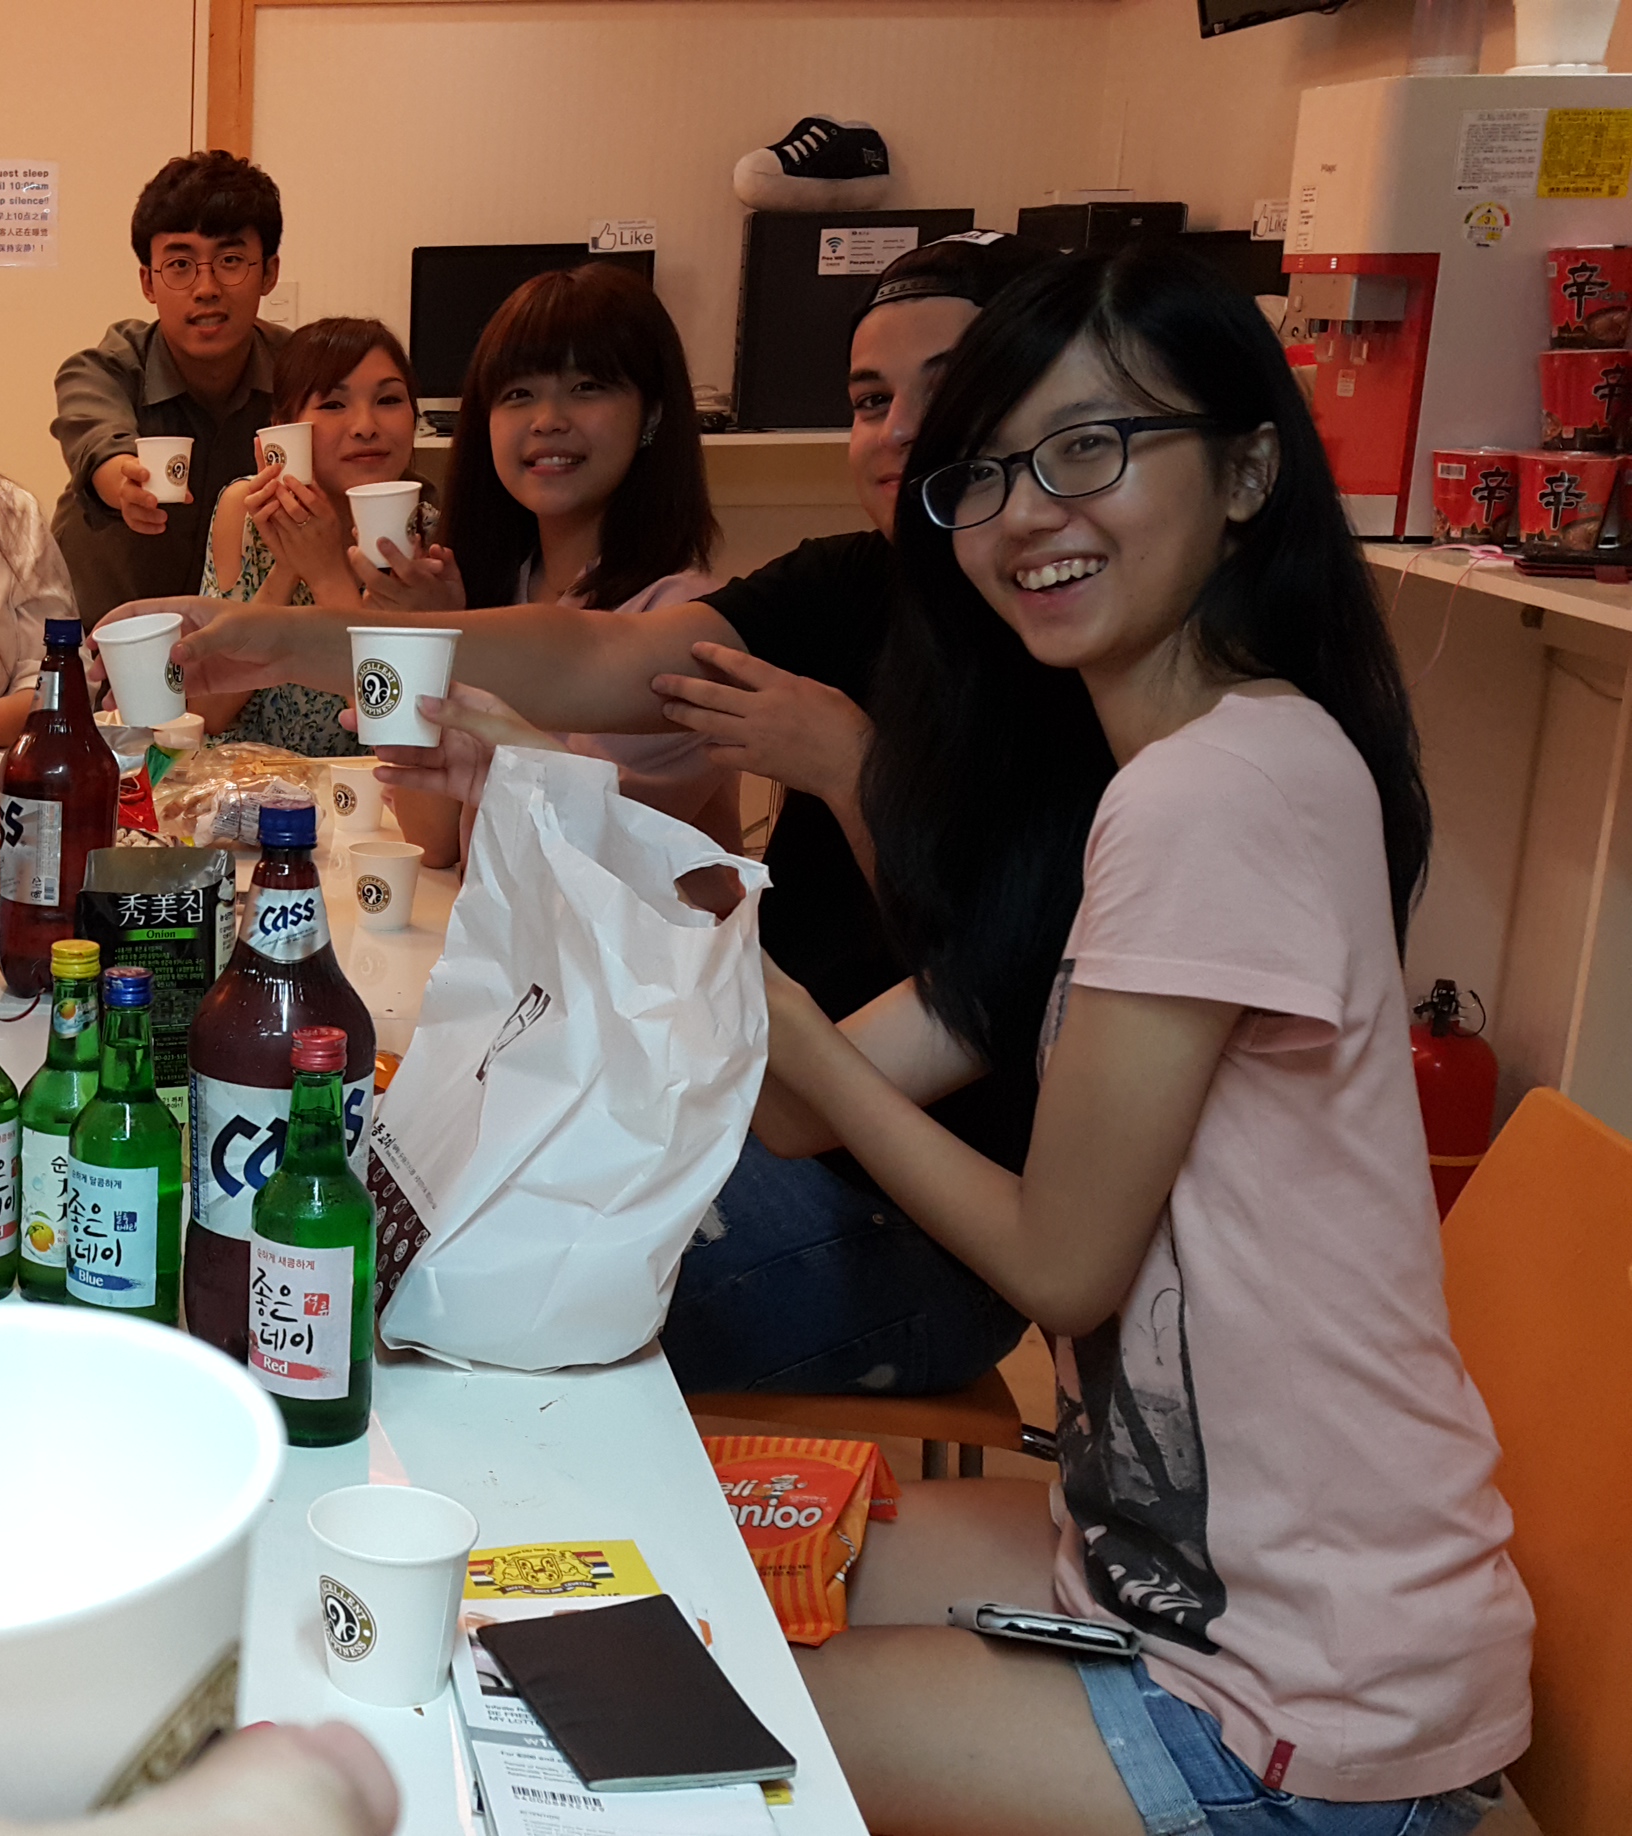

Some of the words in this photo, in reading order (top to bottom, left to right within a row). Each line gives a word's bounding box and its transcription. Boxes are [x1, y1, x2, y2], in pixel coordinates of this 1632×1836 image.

[22, 168, 49, 179] sleep
[9, 181, 49, 191] 10:00am
[620, 230, 654, 246] Like
[1561, 260, 1610, 322] 辛
[1592, 362, 1626, 423] 辛
[1471, 465, 1514, 525] 辛
[1538, 470, 1588, 531] 辛
[358, 662, 397, 683] EXCELLENT
[117, 889, 204, 927] 秀美칩
[146, 929, 176, 939] Onion
[88, 1175, 123, 1190] 달콤하게
[68, 1187, 108, 1238] 좋은
[74, 1238, 123, 1268] 데이
[278, 1255, 316, 1271] 새콤하게
[78, 1269, 104, 1287] Blue
[252, 1266, 299, 1323] 좋은
[304, 1294, 329, 1316] 석류
[260, 1322, 314, 1355] 데이
[263, 1355, 288, 1375] Red
[720, 1479, 759, 1497] eli
[728, 1497, 824, 1530] anjoo
